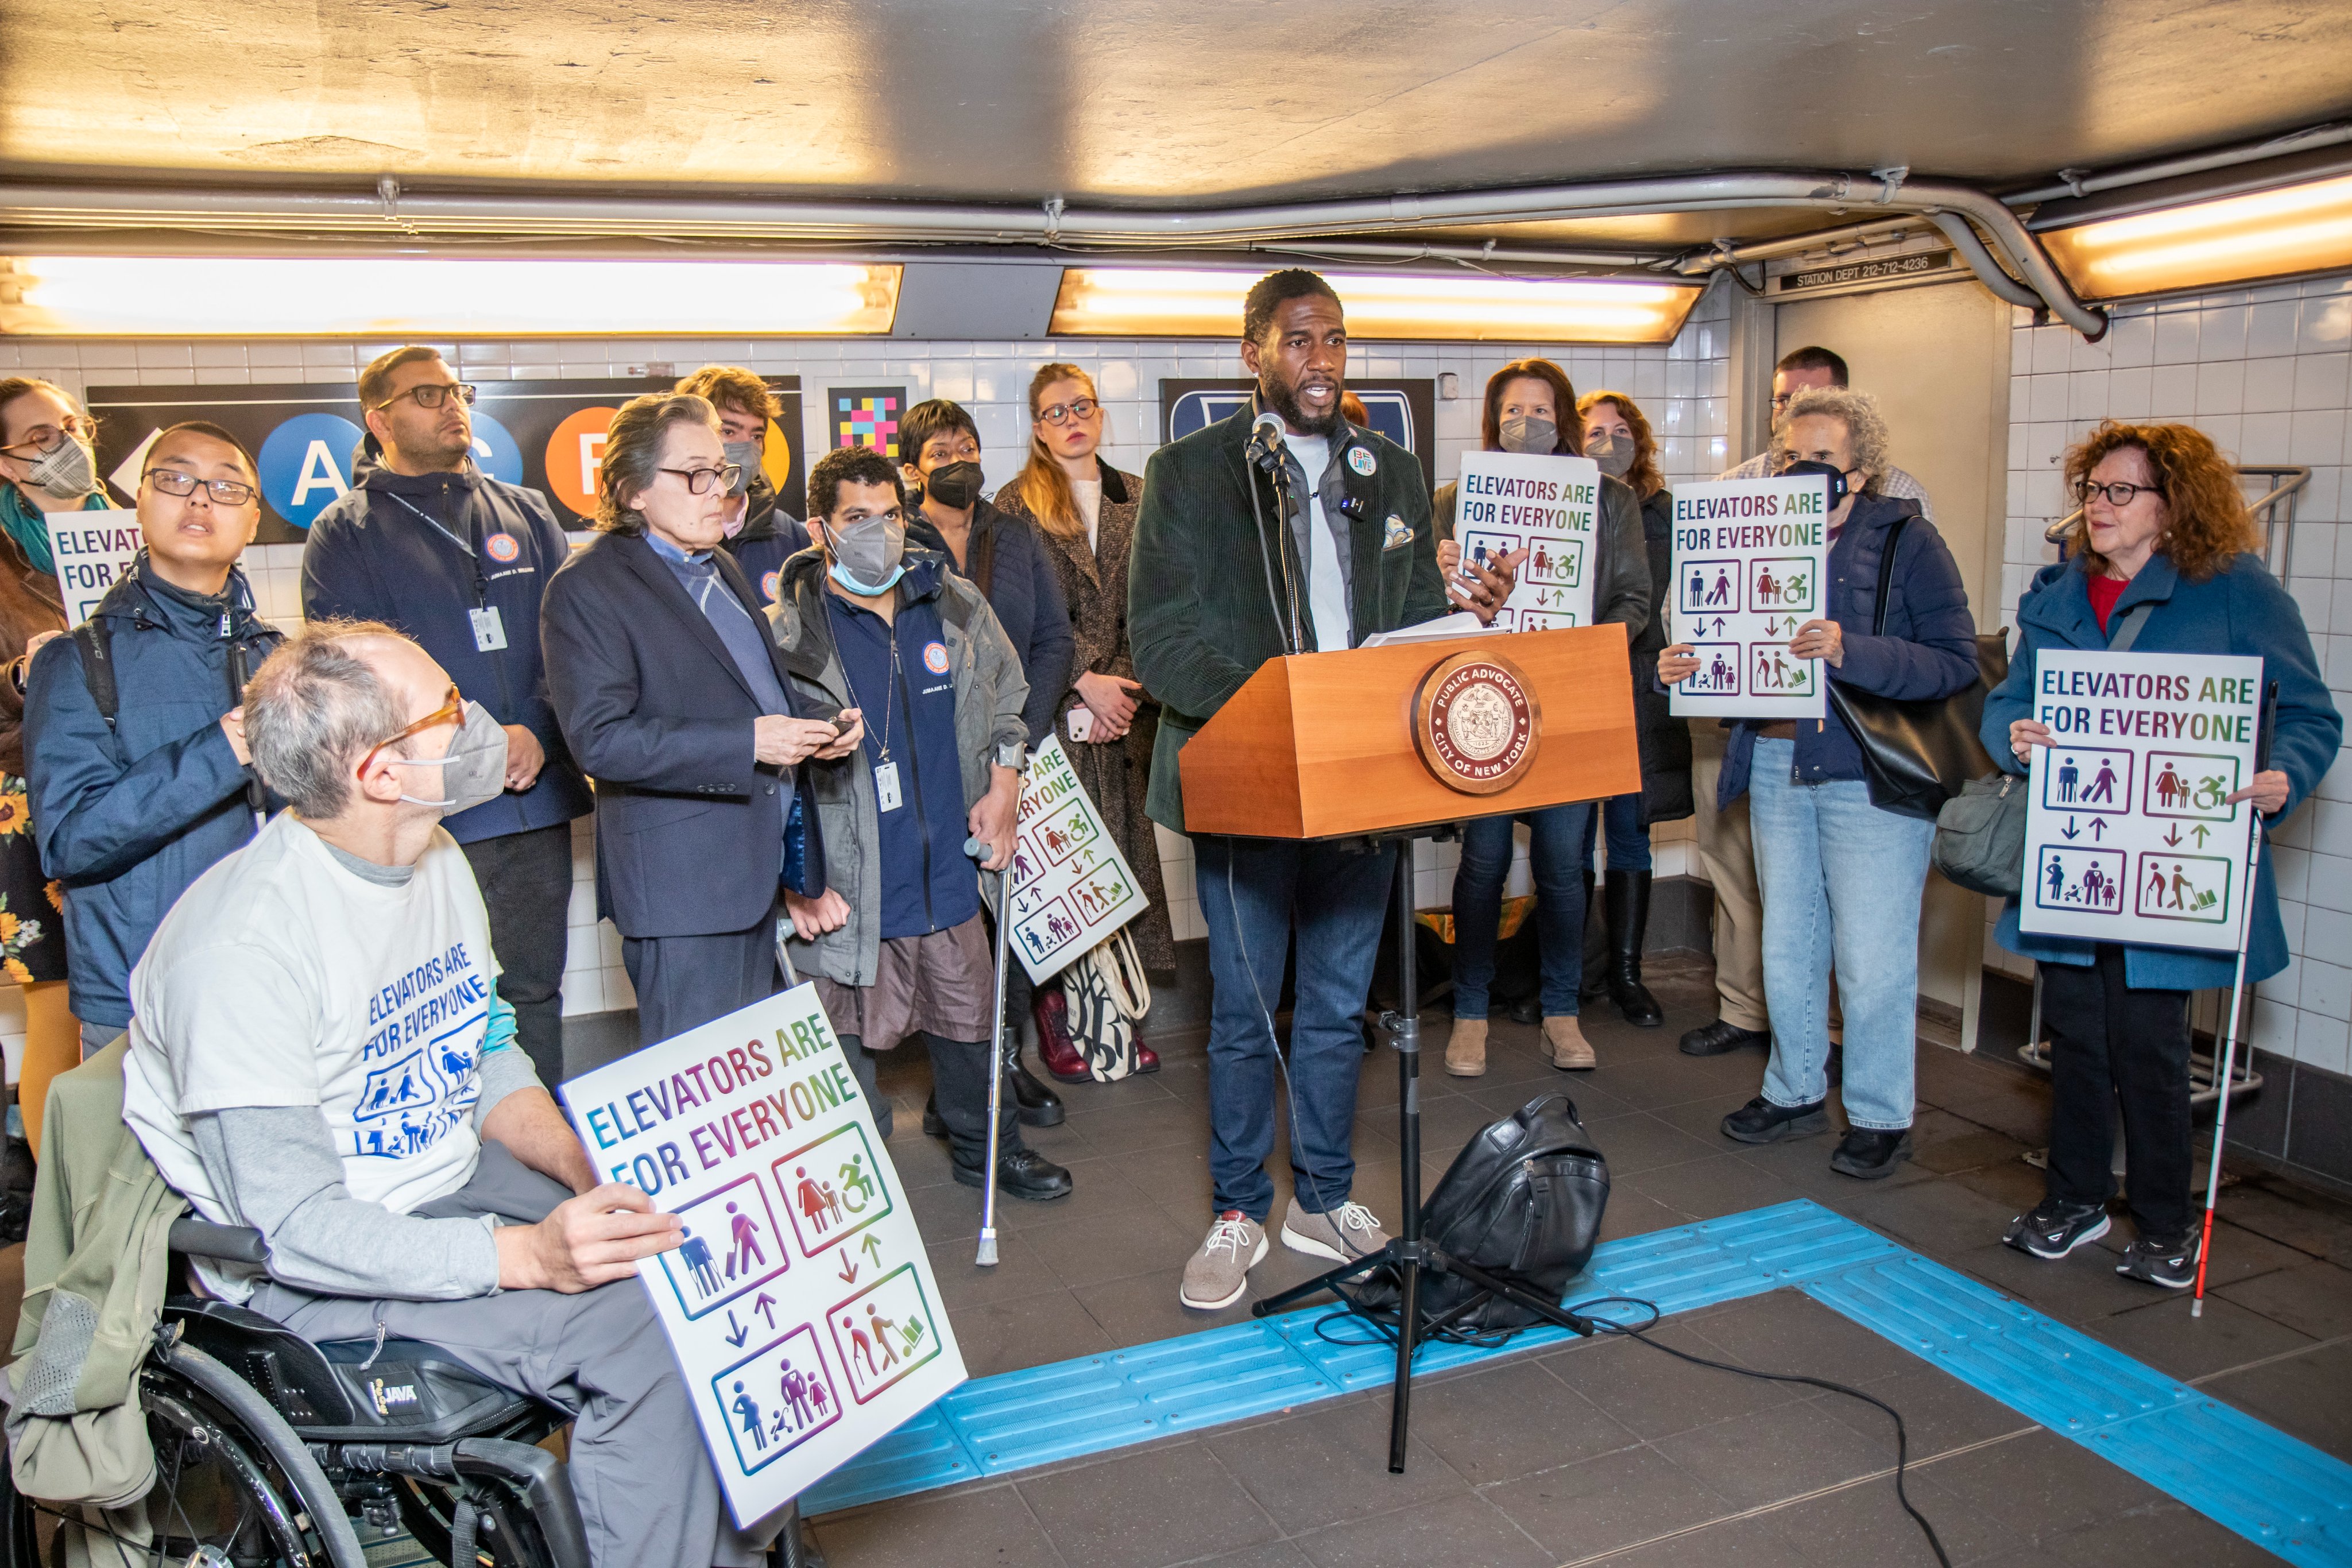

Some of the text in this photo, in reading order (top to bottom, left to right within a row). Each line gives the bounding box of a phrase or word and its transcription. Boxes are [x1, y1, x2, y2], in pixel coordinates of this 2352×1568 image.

[1797, 257, 1928, 287] STATION DEPT 212-712-4236
[291, 440, 350, 506] A
[1354, 458, 1372, 472] LOVE
[1466, 474, 1595, 505] ELEVATORS ARE
[1463, 501, 1592, 532] FOR EVERYONE
[1677, 492, 1823, 521] ELEVATORS ARE
[56, 528, 148, 555] ELEVAT
[1676, 523, 1823, 551] FOR EVERYONE
[64, 563, 113, 590] FOR
[1437, 668, 1524, 708] PUBLIC ADVOCATE
[2042, 669, 2254, 704] ELEVATORS ARE
[2041, 705, 2252, 744] FOR EVERYONE
[1033, 748, 1065, 781] ARE
[1436, 731, 1527, 776] CITY OF NEW YORK
[370, 942, 472, 1027] ELEVATORS ARE
[363, 973, 488, 1061] FOR EVERYONE
[586, 1012, 833, 1151] ELEVATORS ARE
[610, 1062, 858, 1197] FOR EVERYONE
[385, 1384, 417, 1403] JAVA
